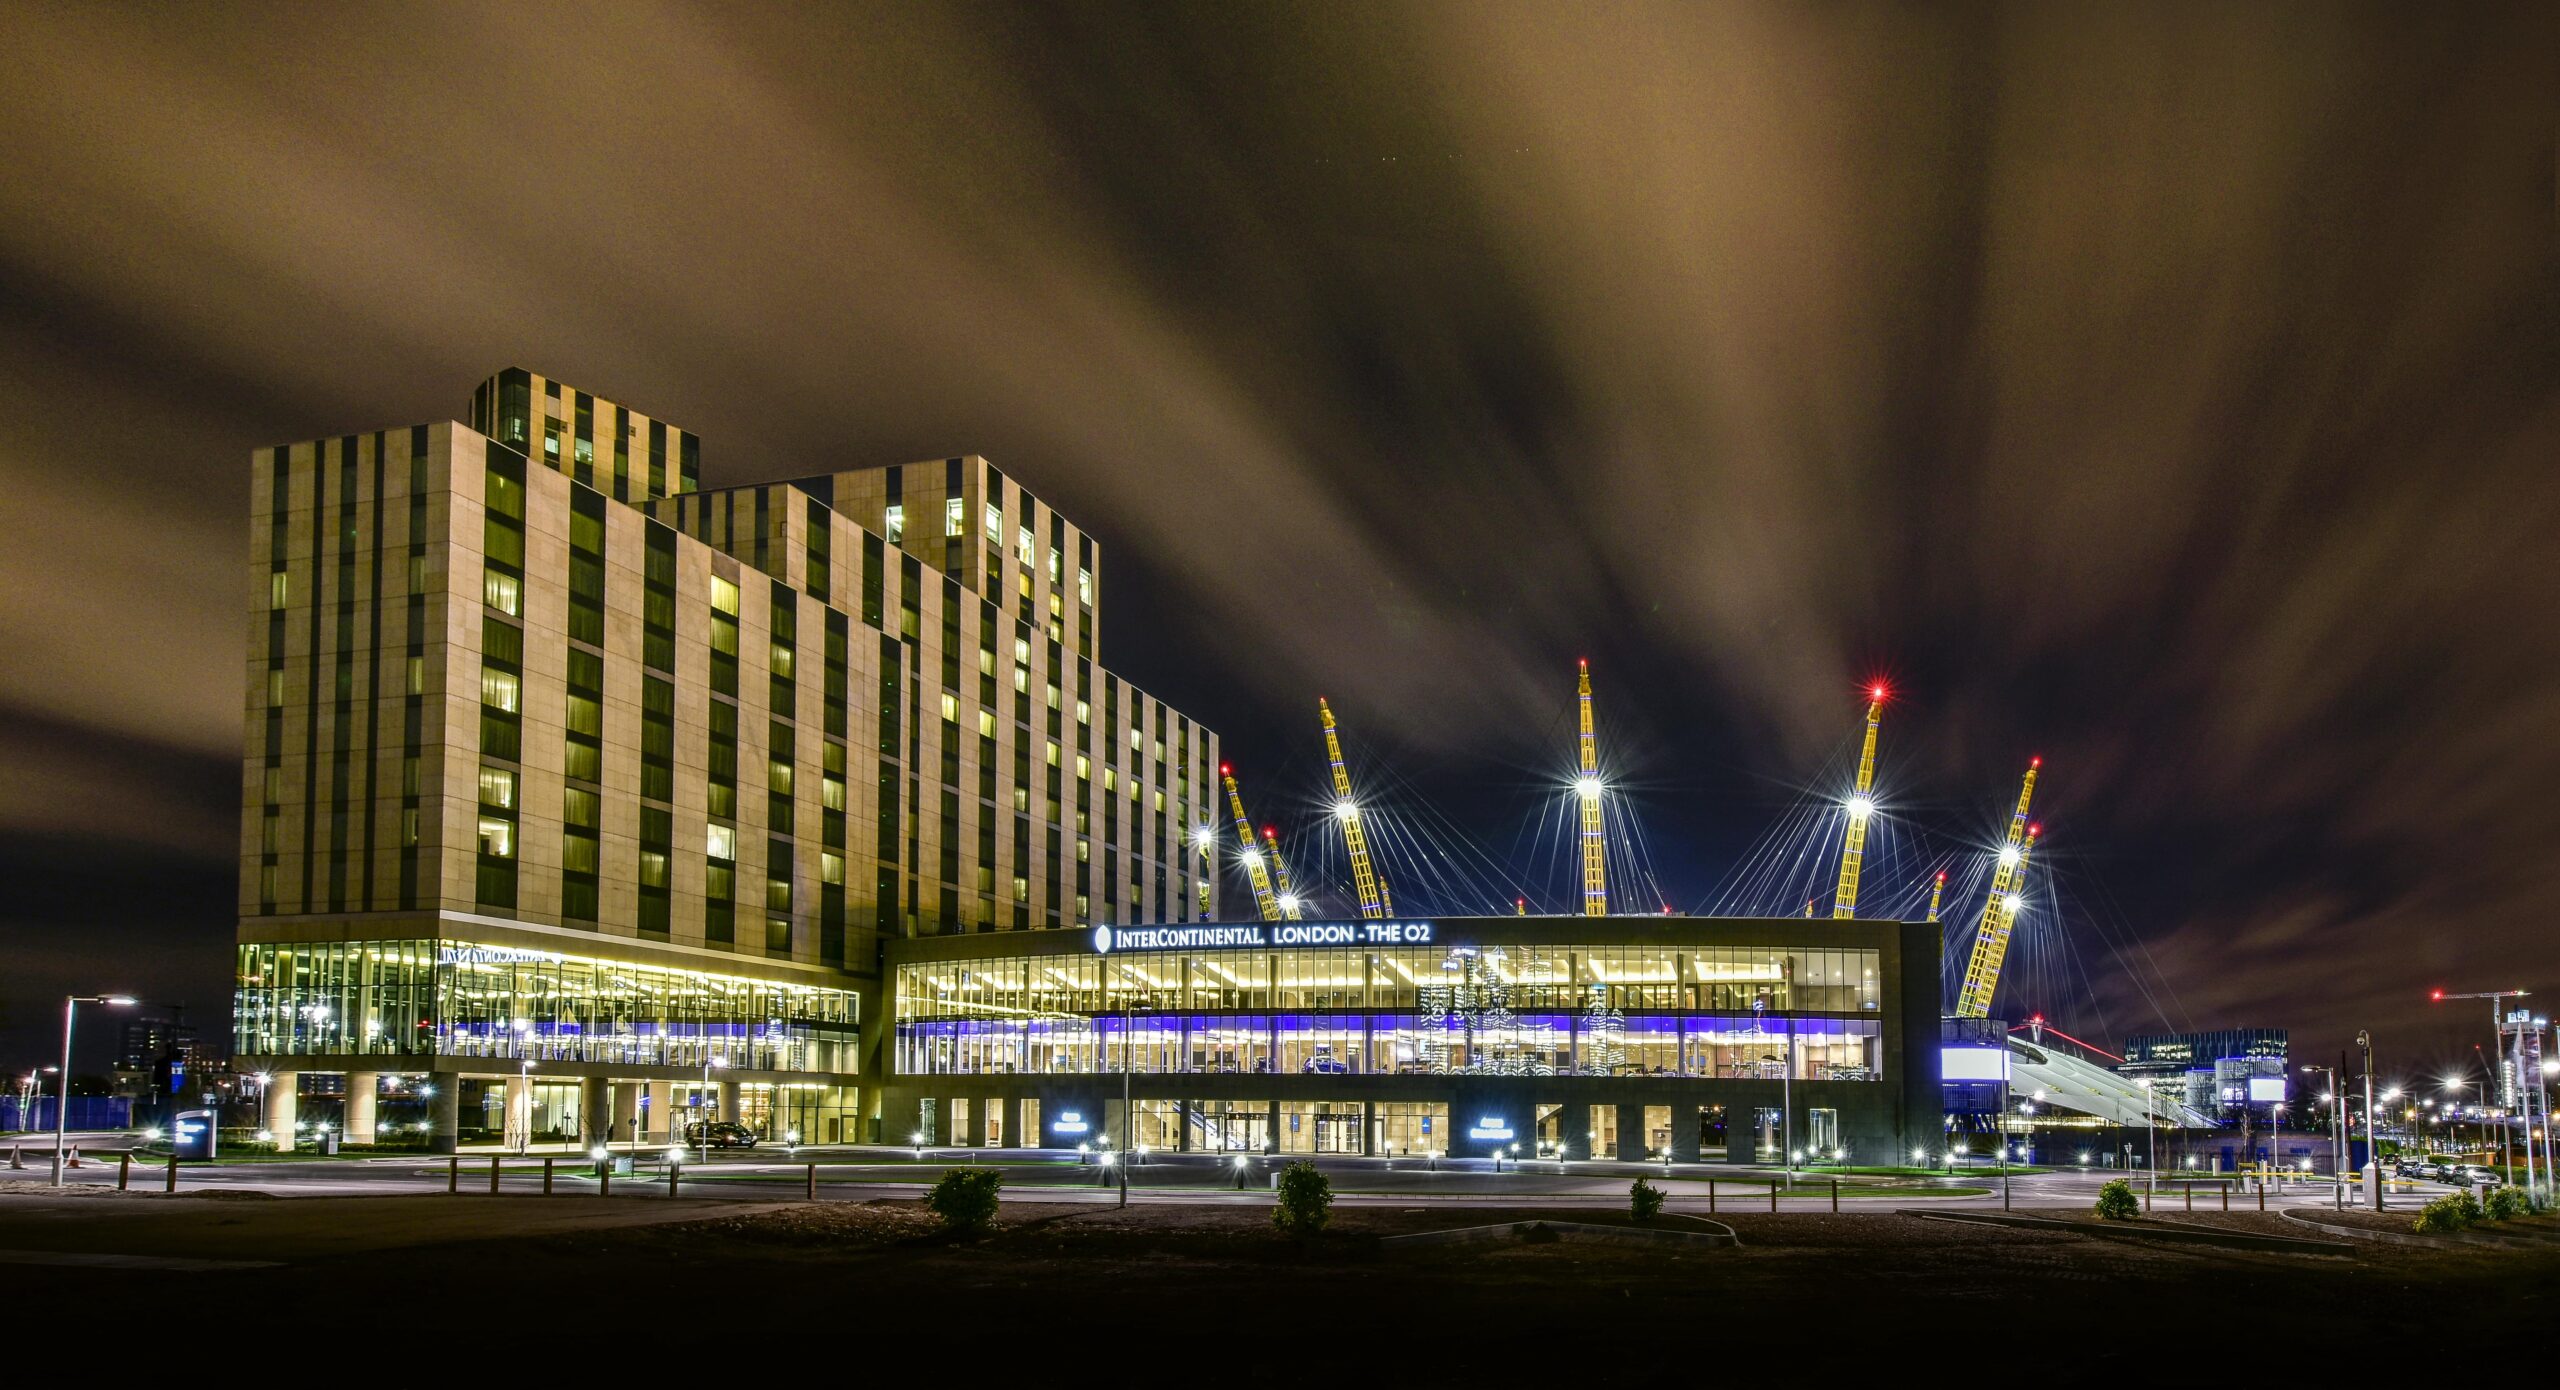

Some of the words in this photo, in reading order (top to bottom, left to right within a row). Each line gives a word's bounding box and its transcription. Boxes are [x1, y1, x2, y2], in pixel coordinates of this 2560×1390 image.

[1274, 925, 1354, 943] LONDON
[1366, 924, 1401, 942] THE
[1404, 924, 1430, 941] O2
